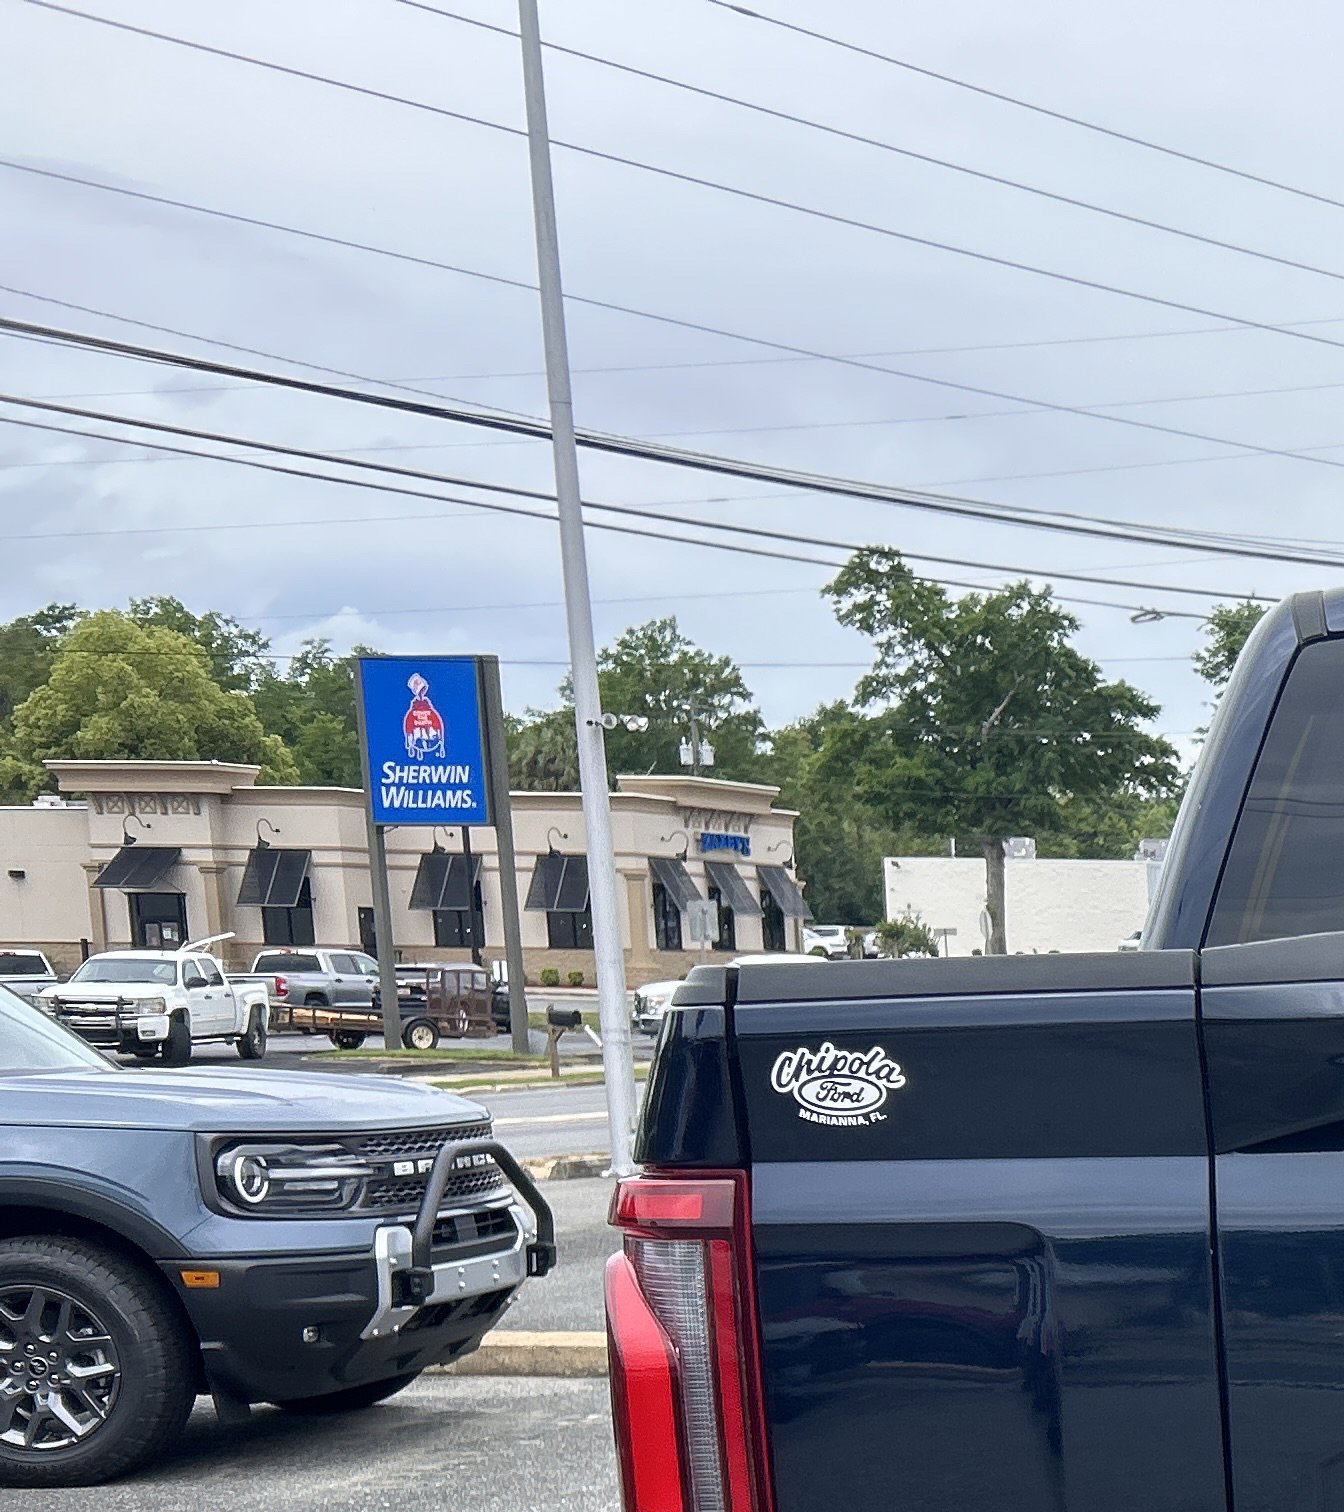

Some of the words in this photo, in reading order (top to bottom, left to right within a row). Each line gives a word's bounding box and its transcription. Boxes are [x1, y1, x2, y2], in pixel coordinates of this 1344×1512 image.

[381, 761, 470, 784] SHERWIN
[773, 1044, 904, 1091] Chipola
[815, 1080, 865, 1103] Ford
